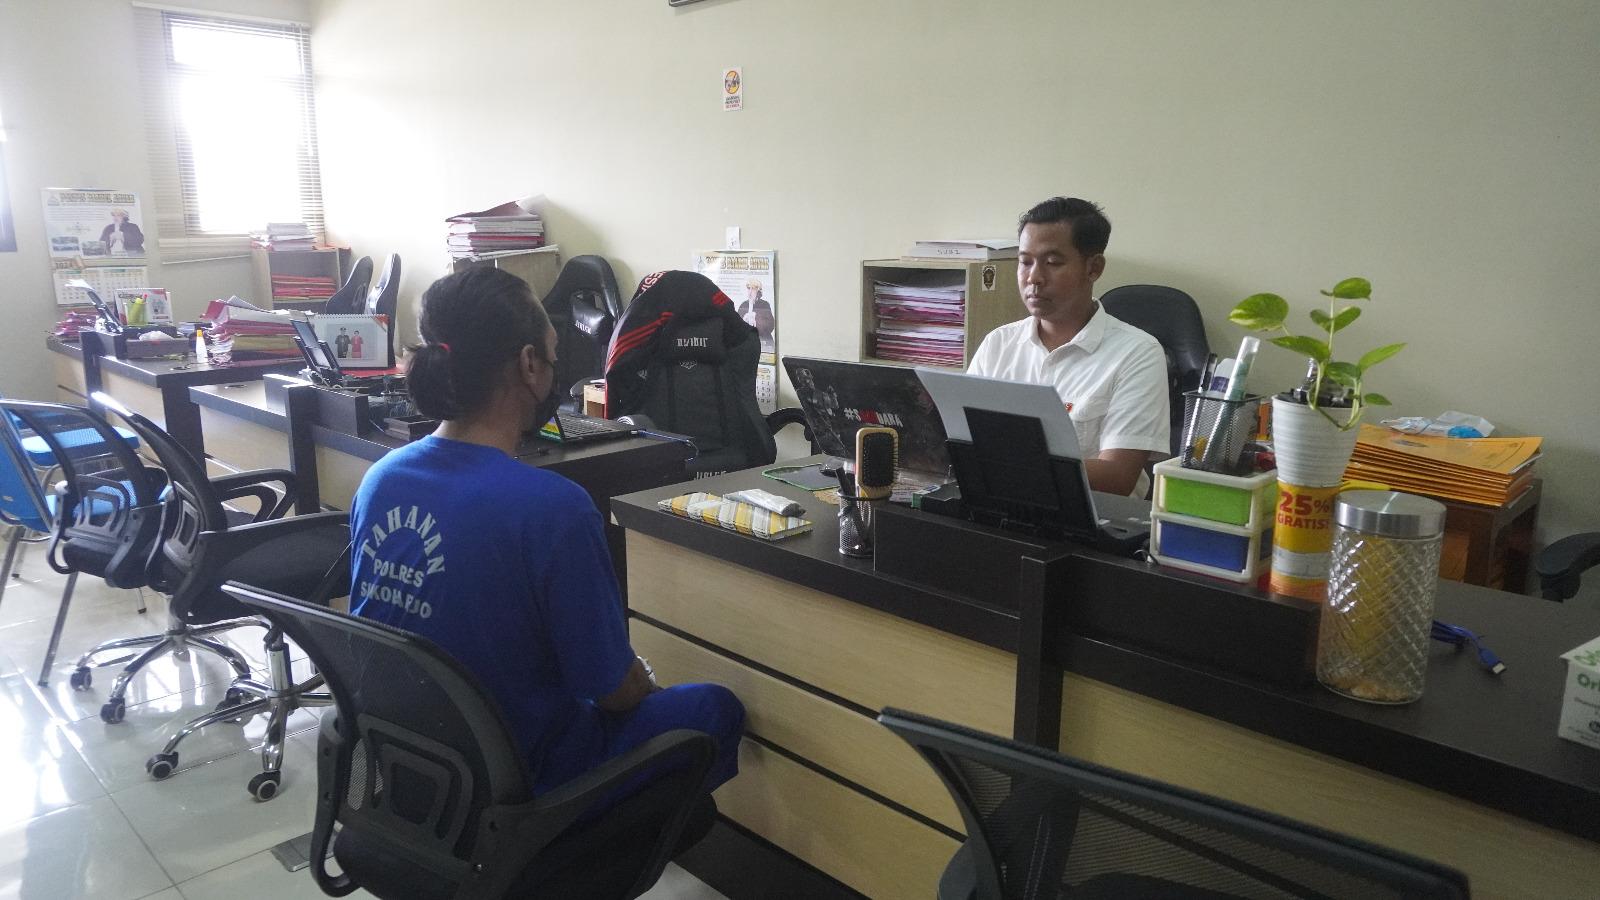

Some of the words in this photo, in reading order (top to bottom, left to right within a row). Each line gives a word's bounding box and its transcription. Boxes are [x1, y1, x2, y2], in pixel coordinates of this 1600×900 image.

[1280, 491, 1329, 515] 25%
[361, 505, 446, 575] TAHANAN
[373, 558, 425, 588] POLRES
